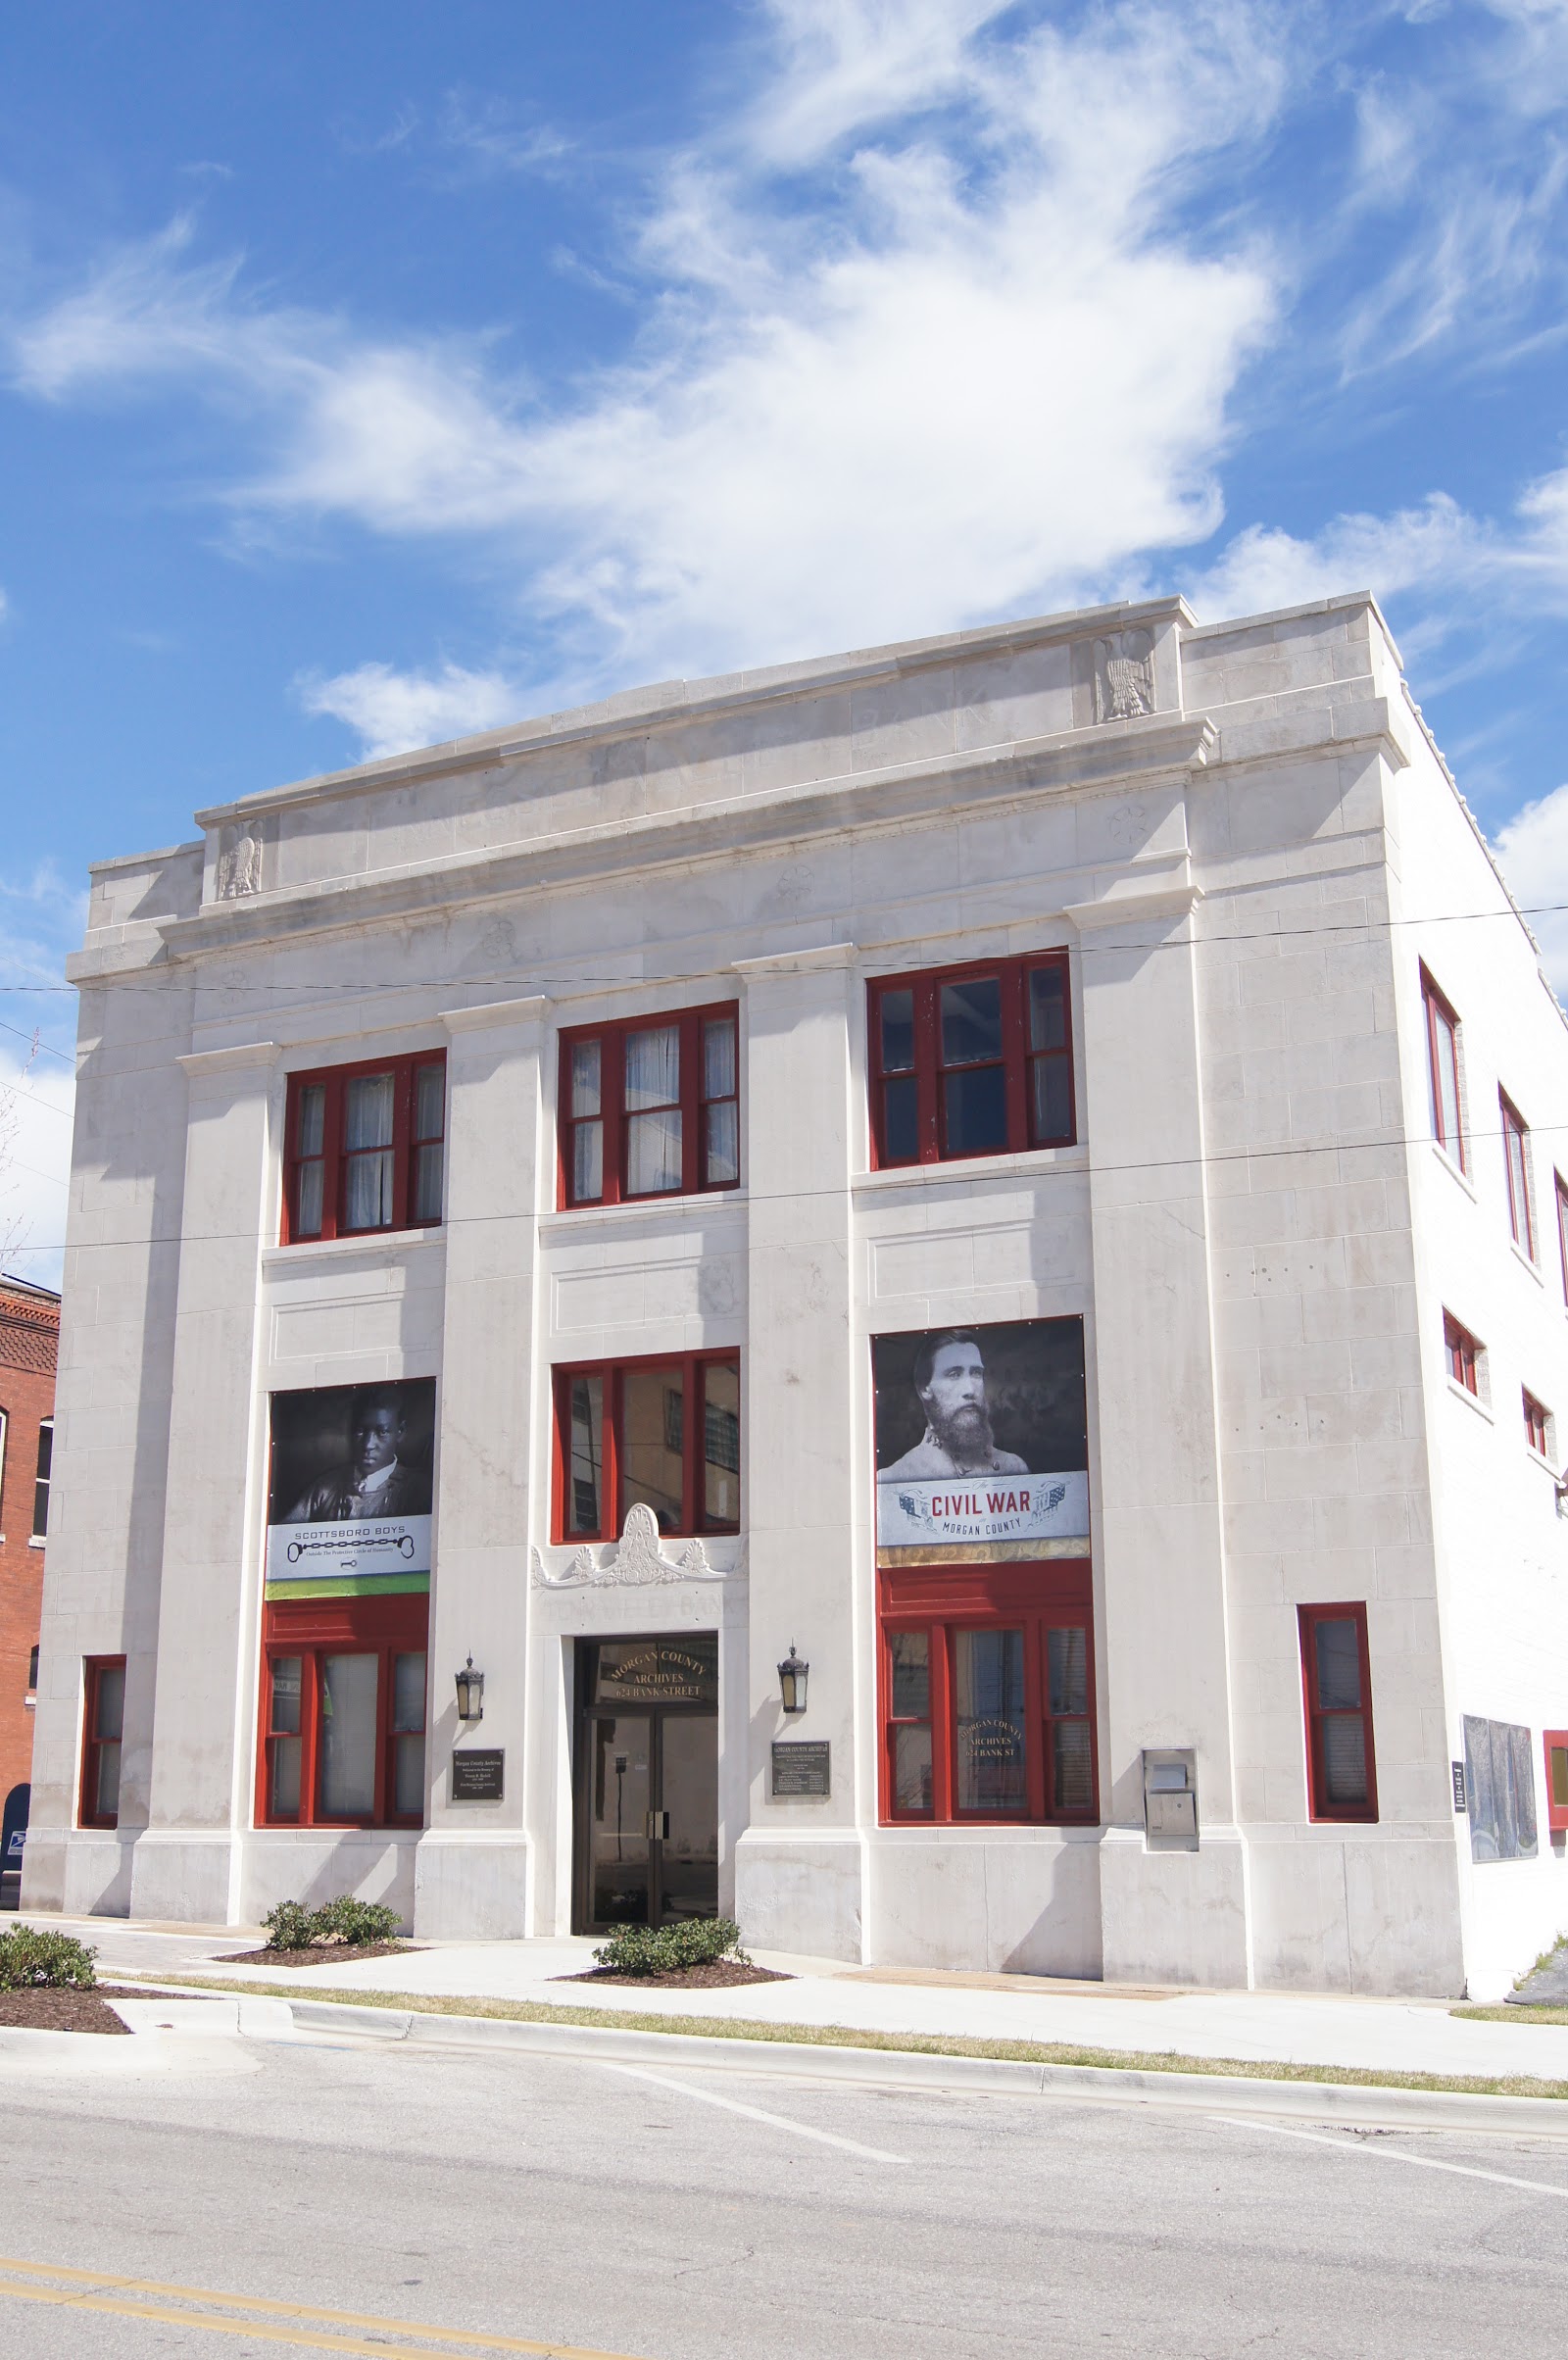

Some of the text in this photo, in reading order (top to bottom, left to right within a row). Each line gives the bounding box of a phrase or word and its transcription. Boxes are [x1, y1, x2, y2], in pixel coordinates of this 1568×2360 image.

[931, 1491, 1031, 1517] CIVIL WAR
[294, 1526, 406, 1540] SCOTTSBORO BOYS
[942, 1518, 1021, 1536] MORGAN COUNTY
[611, 1650, 707, 1682] MORGAN COUNTY
[633, 1673, 684, 1684] ARCHIVES
[615, 1686, 701, 1697] 624 BANK STREET
[960, 1719, 1022, 1740] MORGAN COUNTY
[970, 1737, 1011, 1745] ARCHIVES
[980, 1748, 1003, 1757] BANK
